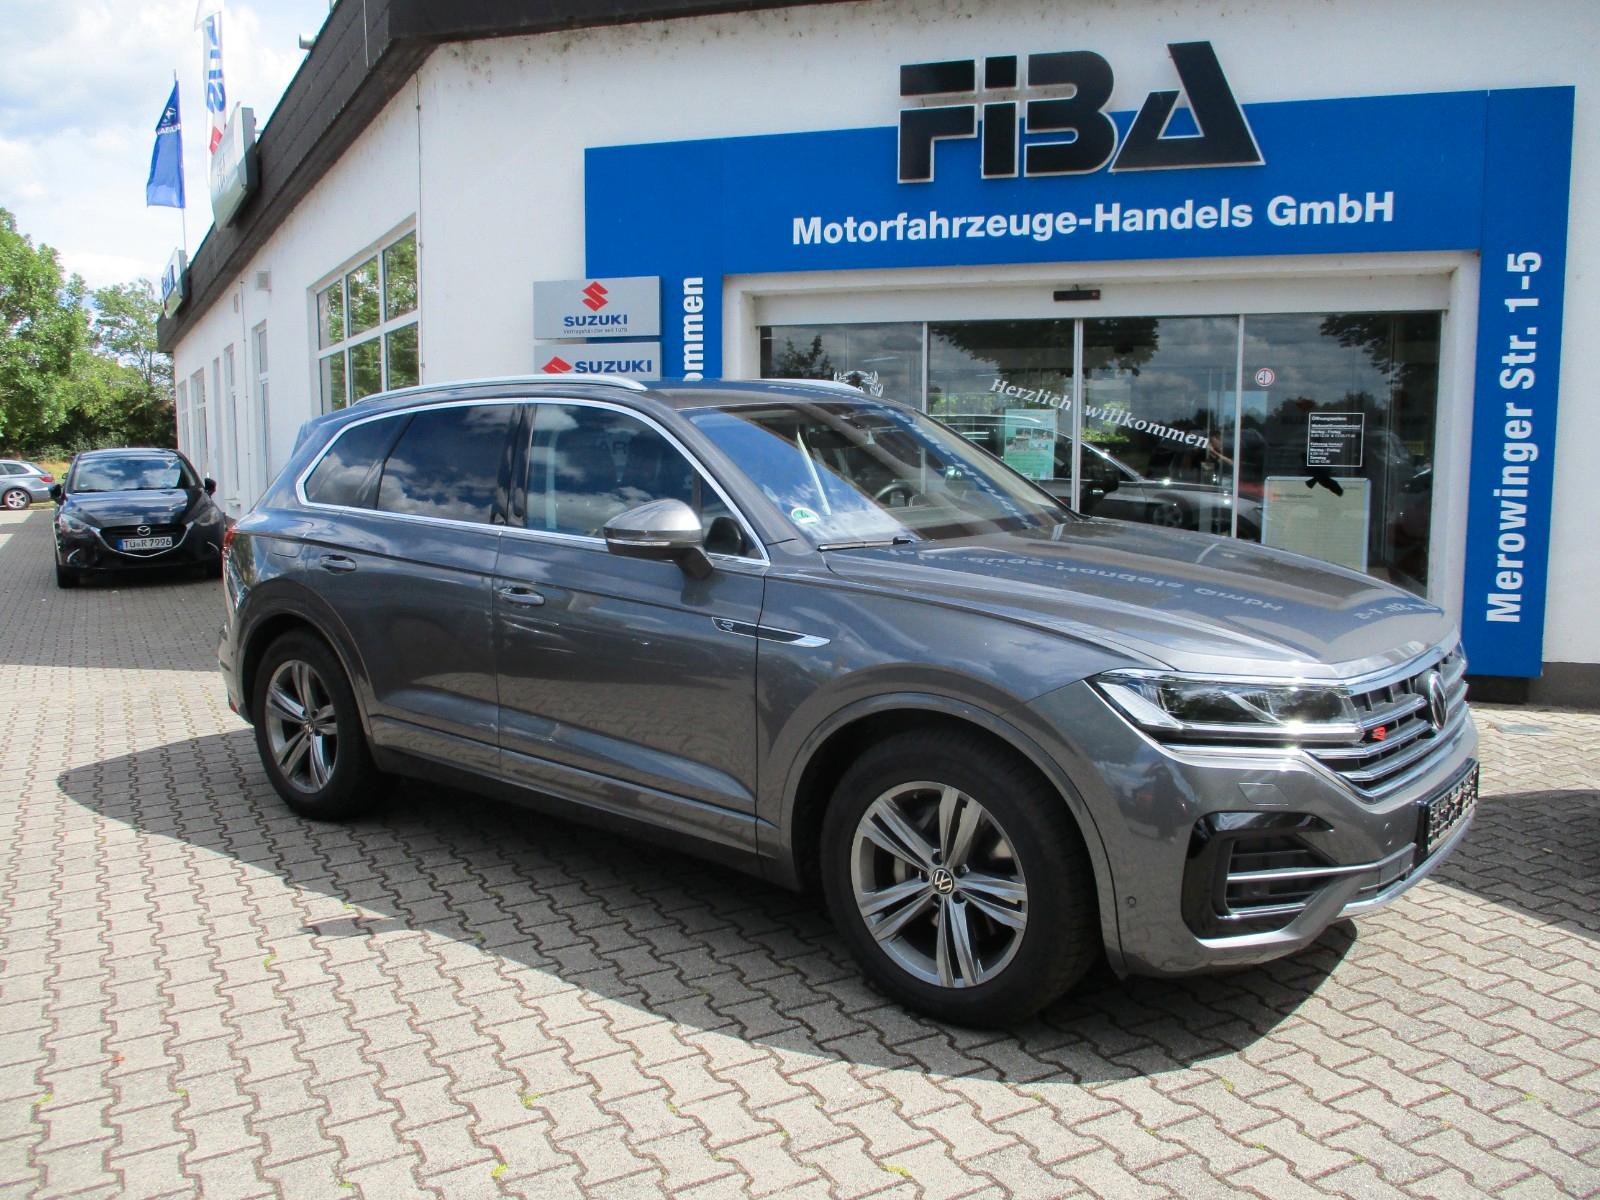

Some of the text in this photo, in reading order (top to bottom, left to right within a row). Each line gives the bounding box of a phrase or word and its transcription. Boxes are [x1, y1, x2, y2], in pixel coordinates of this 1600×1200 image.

[792, 190, 1395, 246] Motorfahrzeuge-Handels GmbH
[563, 314, 629, 327] SUZUKI
[574, 359, 653, 374] SUZUKI
[989, 378, 1210, 449] Herzlich willkommen
[1486, 251, 1542, 623] Merowinger Str. 1-5
